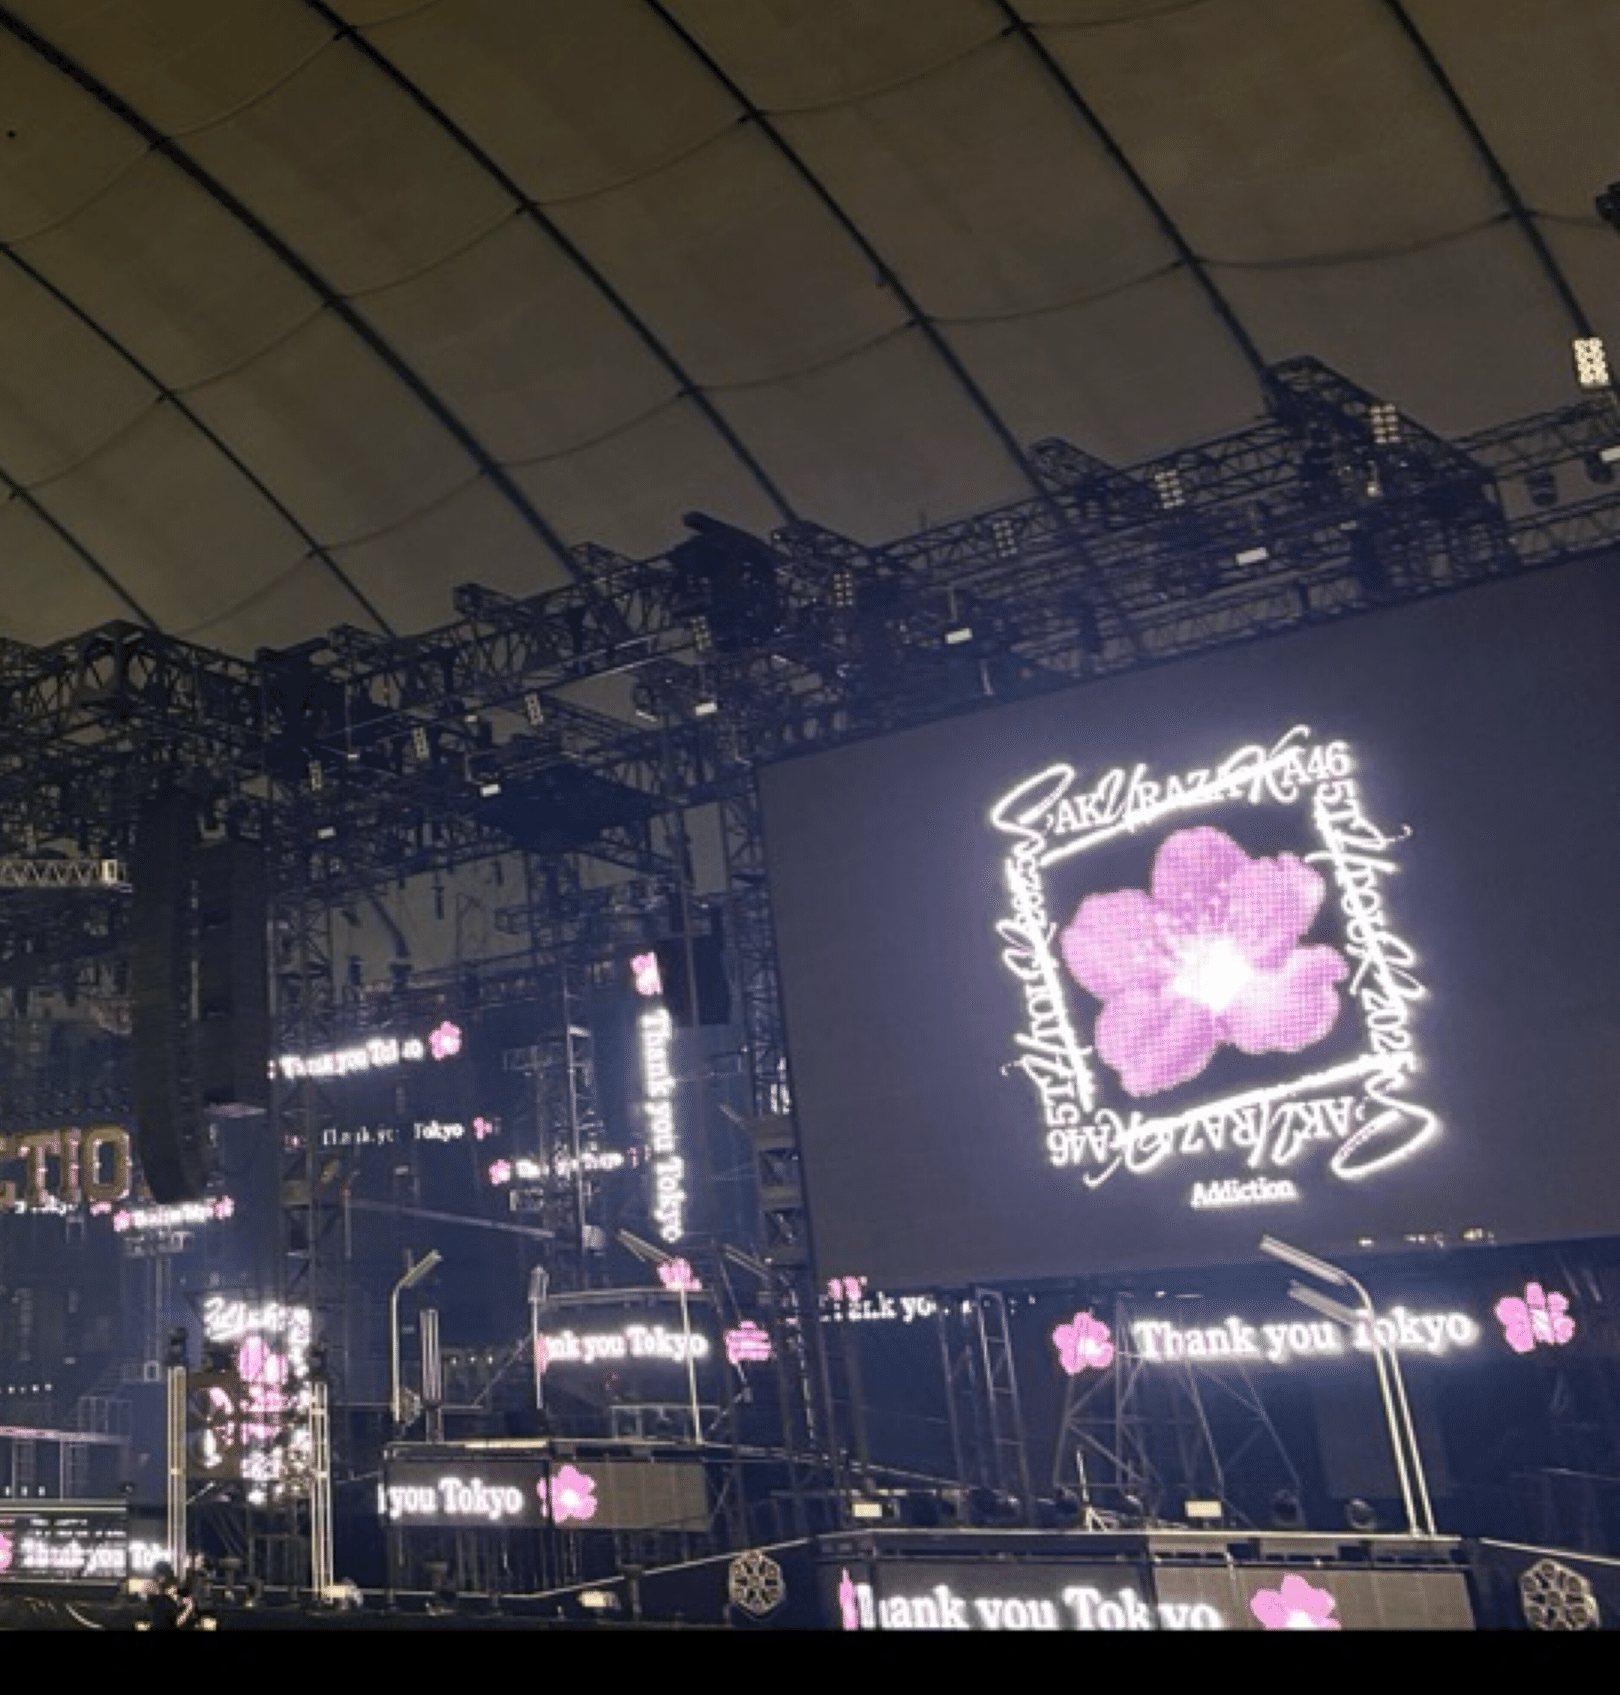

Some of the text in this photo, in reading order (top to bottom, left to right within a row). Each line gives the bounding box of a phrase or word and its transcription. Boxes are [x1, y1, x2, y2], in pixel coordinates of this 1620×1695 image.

[639, 1008, 687, 1243] Thank you Tokyo
[1190, 1177, 1299, 1208] Addiction
[582, 1335, 626, 1364] you
[626, 1323, 709, 1362] Tokyo
[1132, 1305, 1476, 1363] Thank you Tokyo
[389, 1475, 524, 1521] you Tokyo
